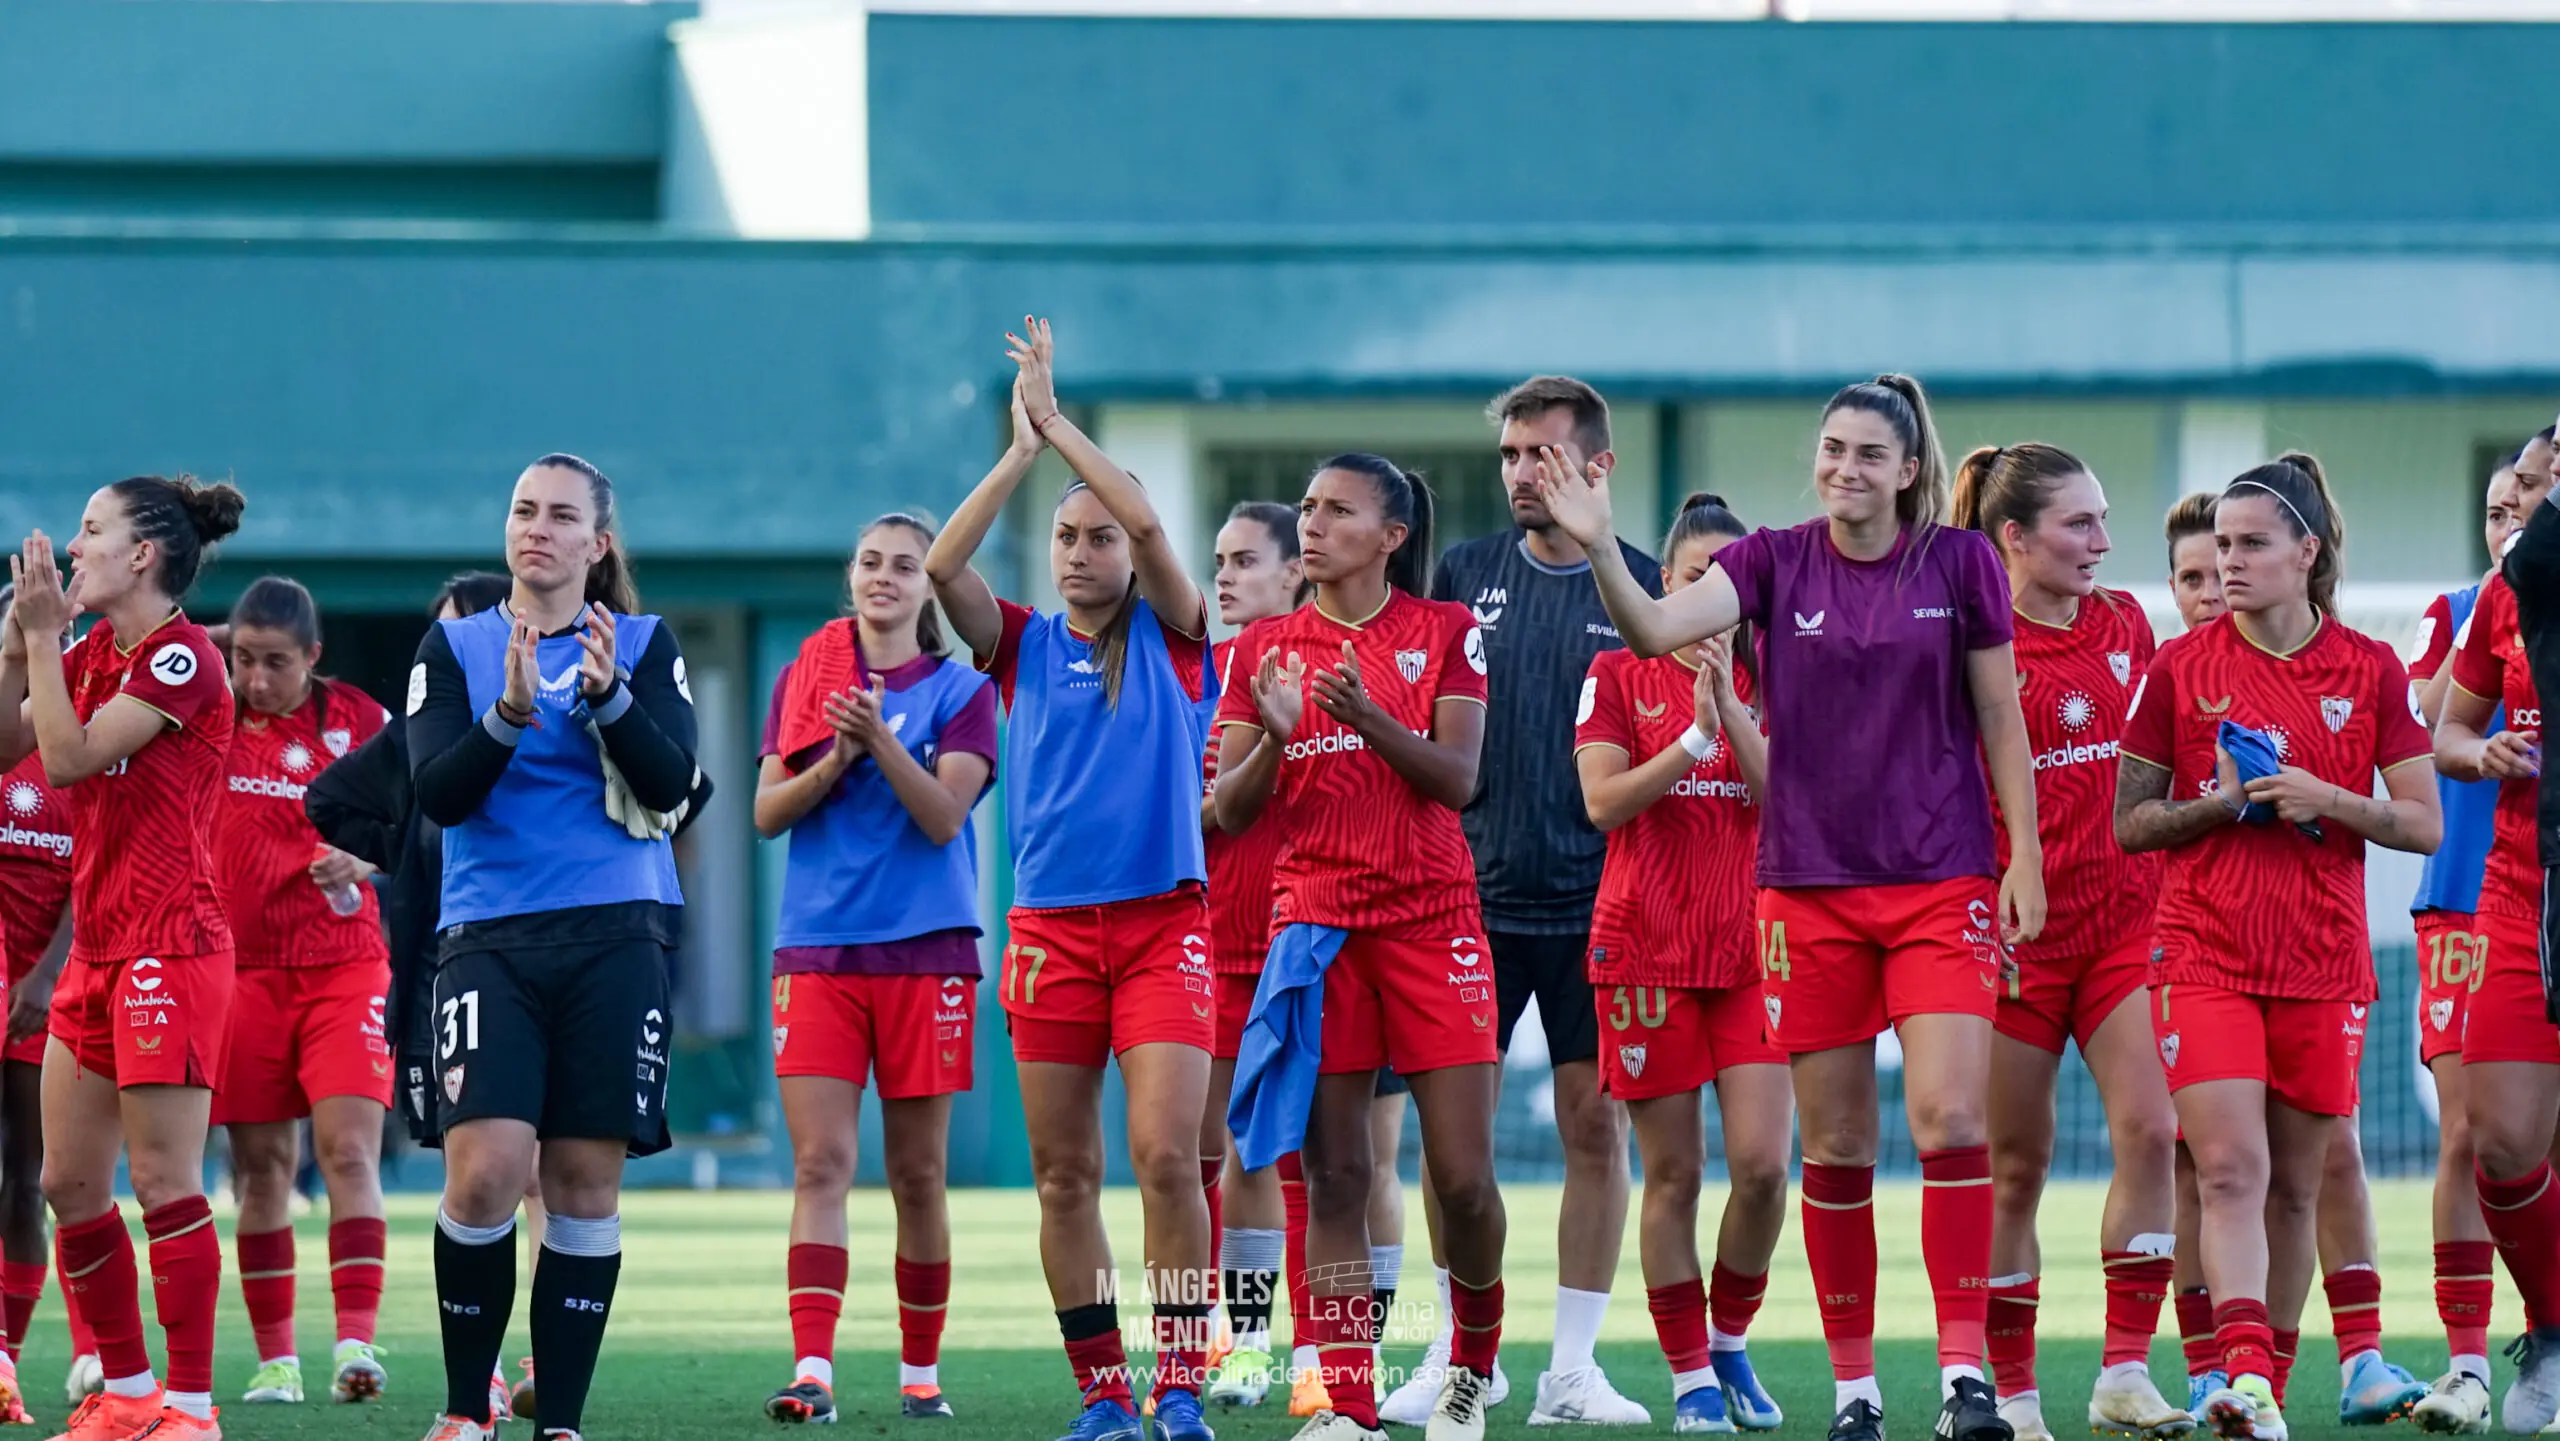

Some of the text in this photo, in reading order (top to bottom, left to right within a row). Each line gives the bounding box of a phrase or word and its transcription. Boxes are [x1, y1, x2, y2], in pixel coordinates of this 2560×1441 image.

[1475, 587, 1508, 605] JM
[154, 653, 192, 676] JD
[1758, 918, 1791, 982] 14
[2428, 930, 2474, 990] 16
[1008, 943, 1048, 1004] 17
[441, 988, 480, 1061] 31
[442, 1299, 481, 1316] SFC
[563, 1297, 605, 1313] SFC
[1824, 1293, 1859, 1305] SFC
